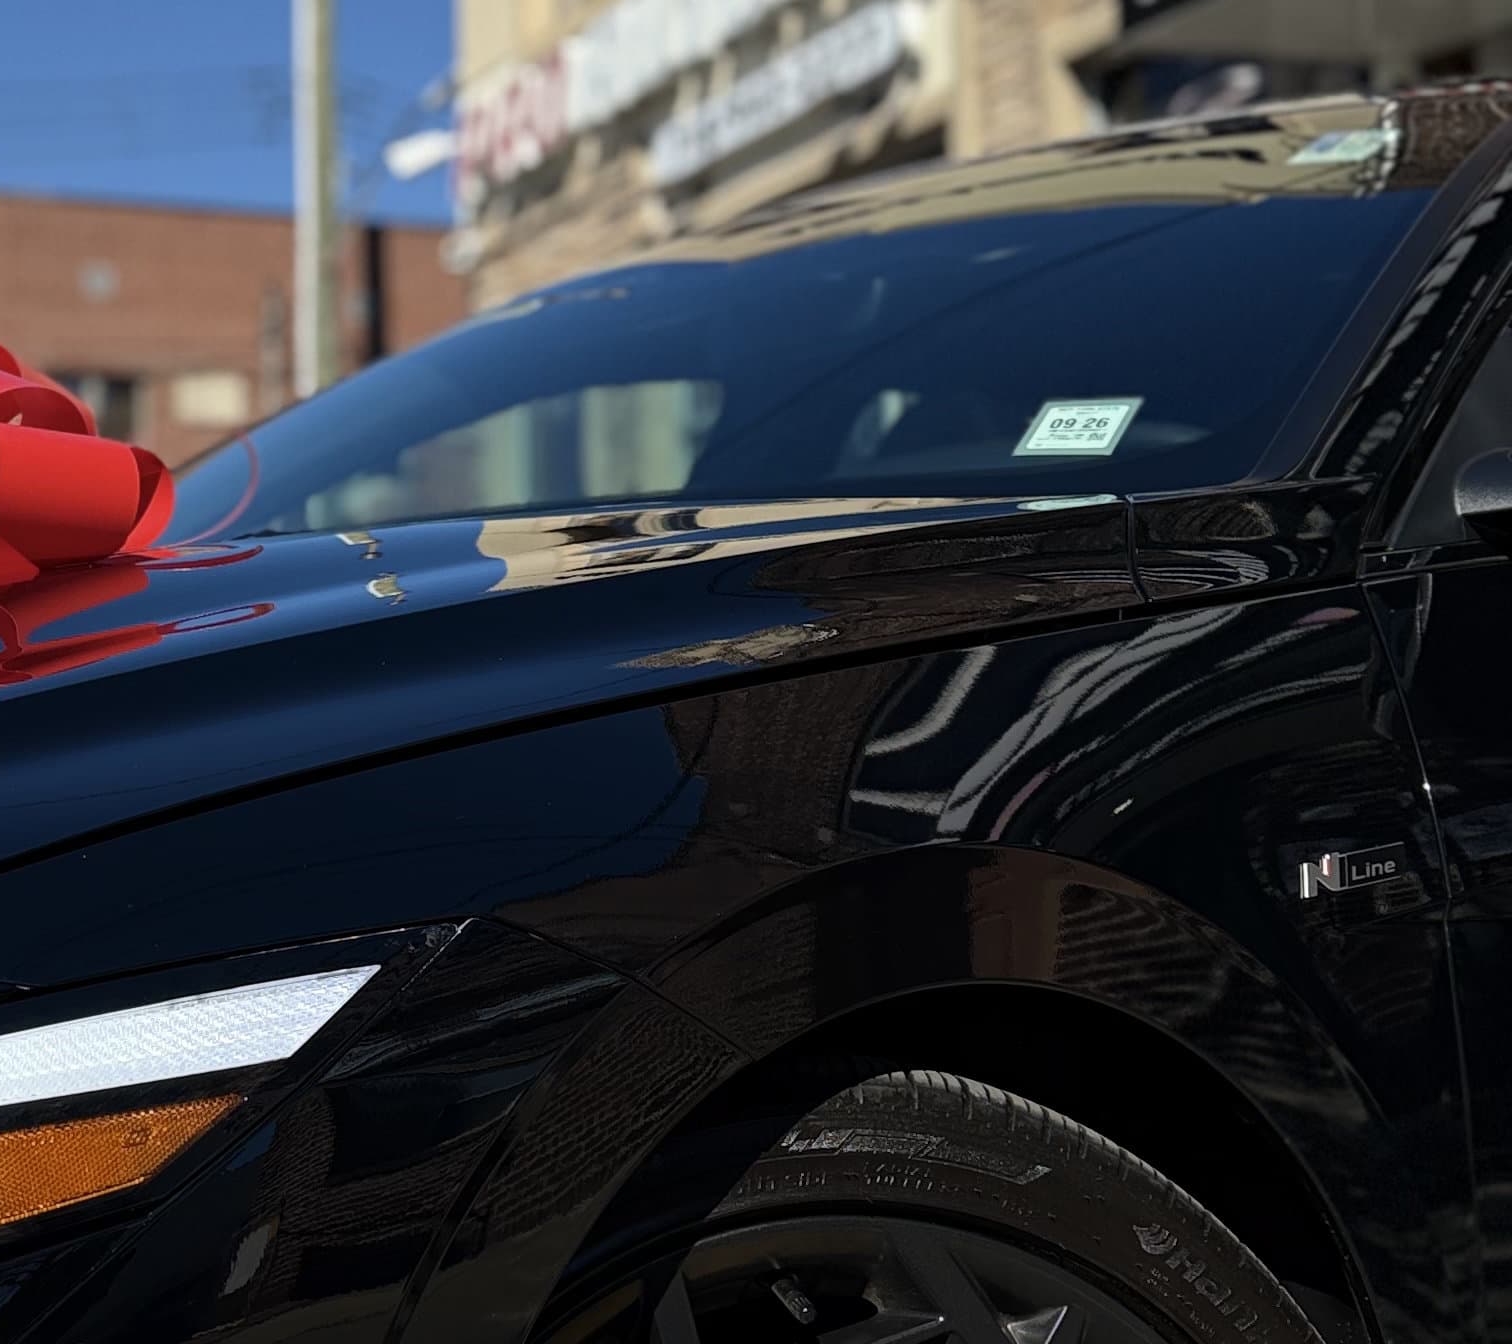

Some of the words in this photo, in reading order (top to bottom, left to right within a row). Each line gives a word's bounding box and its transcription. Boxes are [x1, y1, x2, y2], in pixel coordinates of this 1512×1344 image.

[1050, 418, 1077, 429] 09
[1082, 417, 1110, 429] 26
[1300, 852, 1339, 899] N
[1352, 860, 1396, 881] Line
